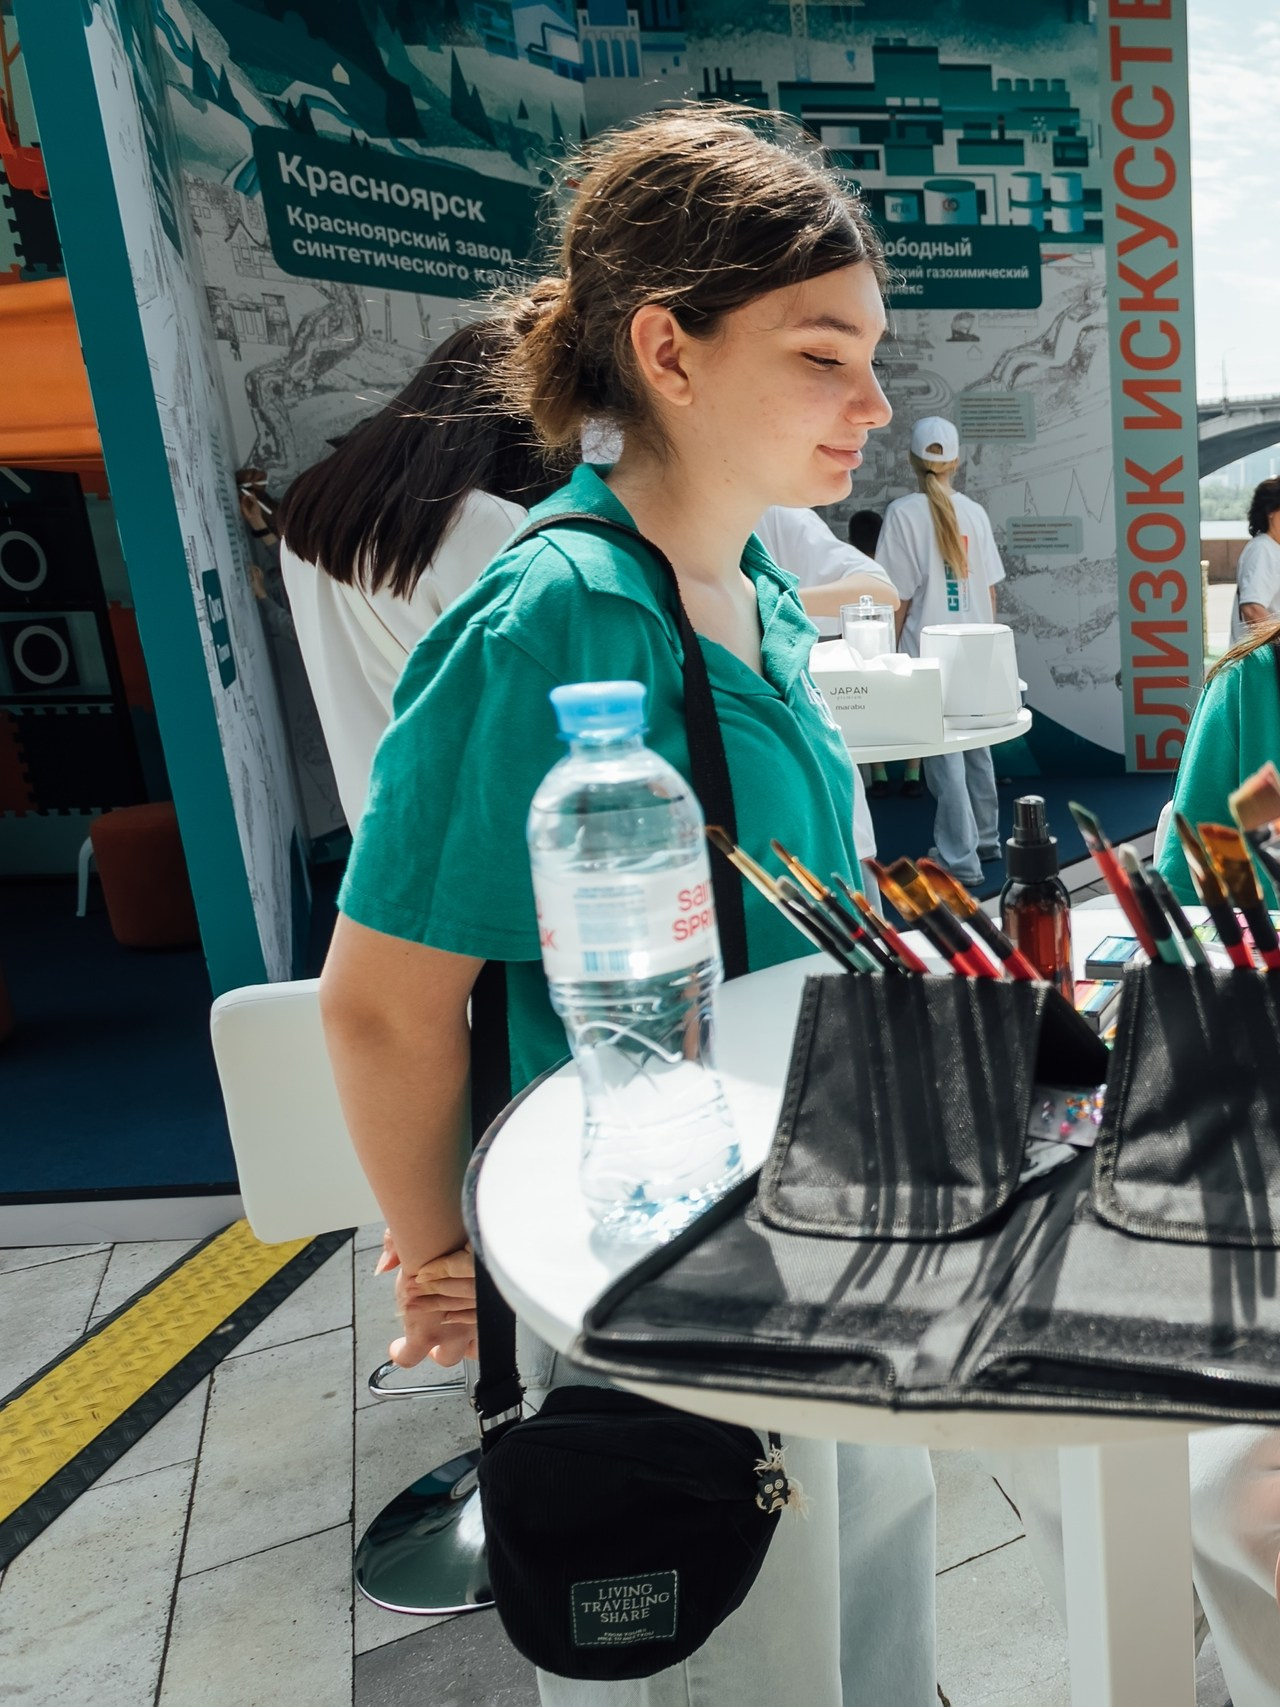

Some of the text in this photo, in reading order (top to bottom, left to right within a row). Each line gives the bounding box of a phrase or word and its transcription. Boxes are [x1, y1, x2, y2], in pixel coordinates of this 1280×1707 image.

[278, 152, 486, 222] Красноярск
[286, 205, 515, 267] Красноярский завод
[883, 237, 972, 260] ободный
[293, 238, 469, 281] синтетического
[926, 266, 1030, 279] газохимический
[883, 284, 924, 295] плекс
[1124, 455, 1190, 771] БЛИЗОК
[830, 686, 868, 696] JAPAN
[598, 1583, 653, 1600] LIVING
[581, 1592, 670, 1613] TRAVELING
[600, 1607, 651, 1623] SHARE
